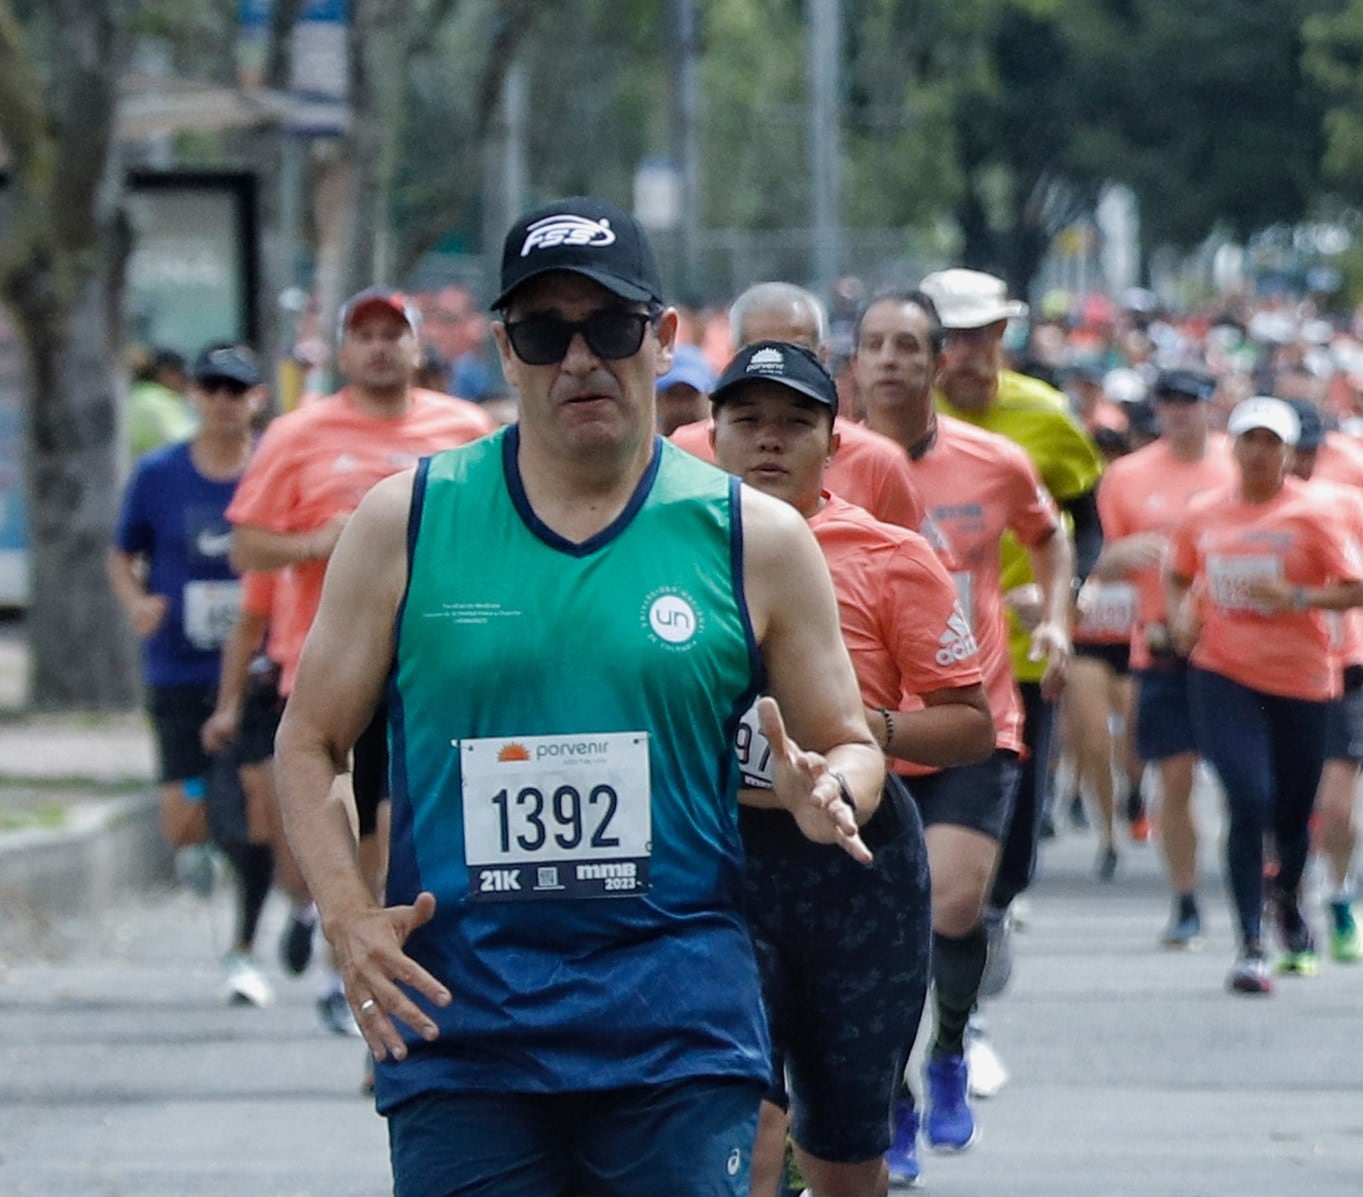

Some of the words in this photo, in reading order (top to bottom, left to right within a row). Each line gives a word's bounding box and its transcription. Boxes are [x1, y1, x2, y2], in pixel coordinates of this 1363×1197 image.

[656, 608, 689, 629] un
[536, 741, 609, 760] porvenir
[491, 784, 620, 853] 1392
[479, 869, 522, 892] 21K
[576, 862, 637, 880] mmB
[604, 878, 637, 891] 2023
